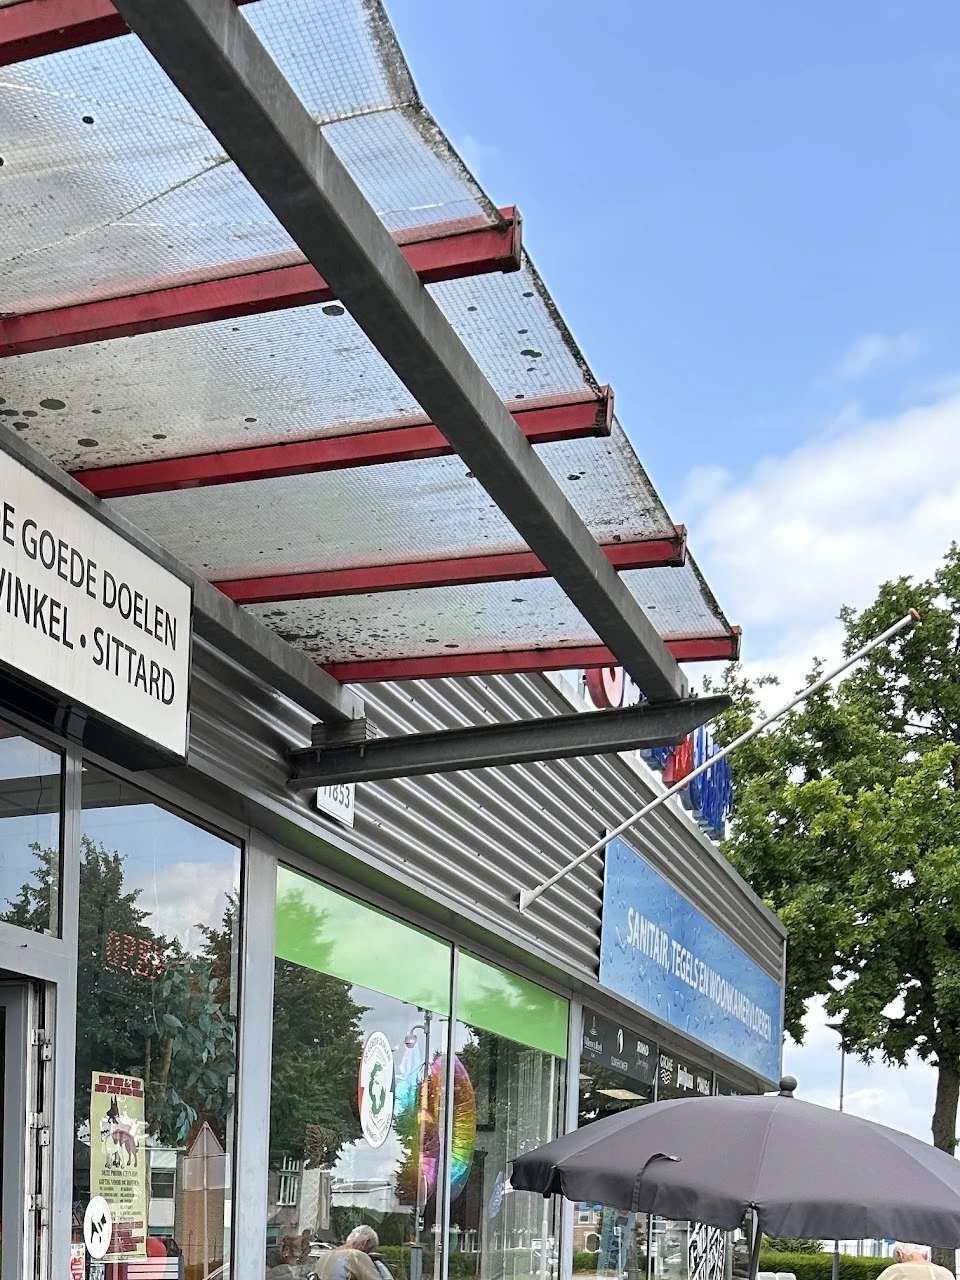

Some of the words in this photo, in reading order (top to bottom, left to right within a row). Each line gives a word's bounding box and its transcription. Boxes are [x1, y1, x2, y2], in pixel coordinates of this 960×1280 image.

[21, 518, 97, 600] GOEDE
[102, 569, 177, 651] DOELEN
[92, 626, 175, 705] SITTARD
[626, 906, 670, 975] SANITAIR,
[671, 939, 699, 990] TEGELS
[698, 962, 709, 996] EN
